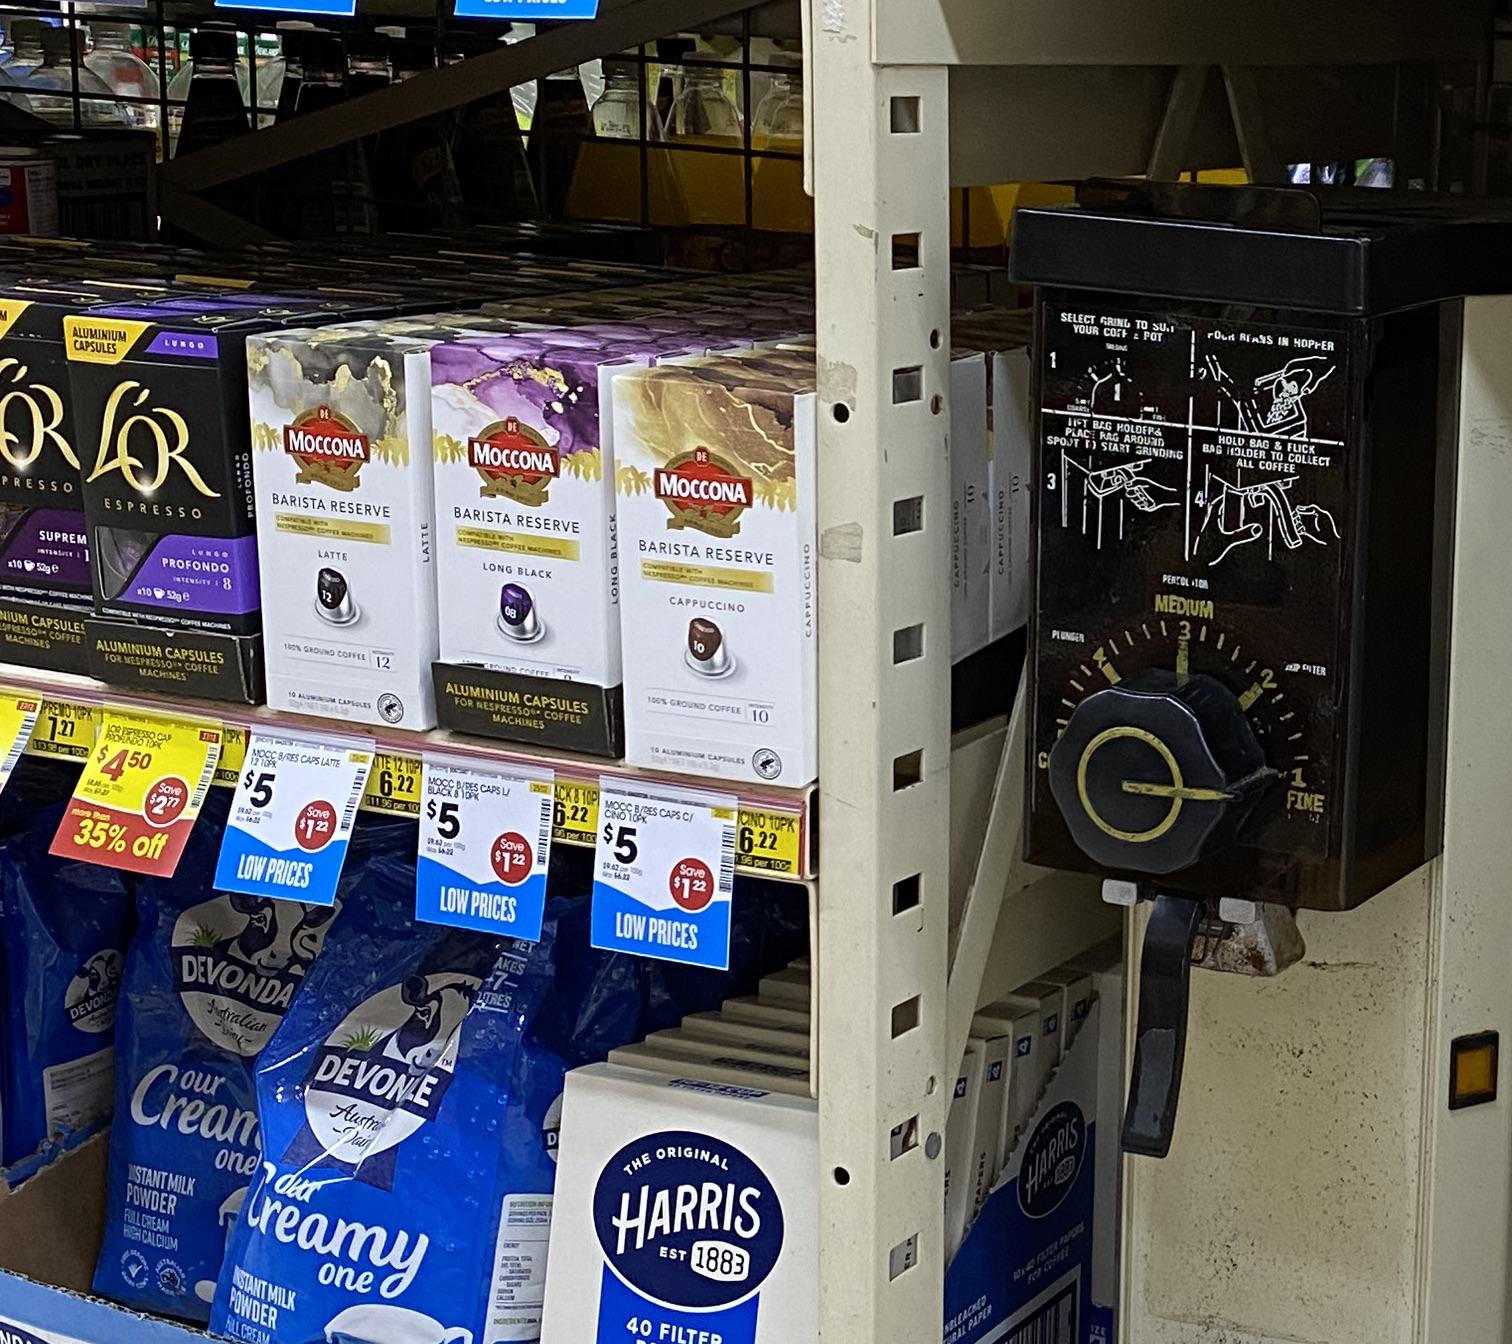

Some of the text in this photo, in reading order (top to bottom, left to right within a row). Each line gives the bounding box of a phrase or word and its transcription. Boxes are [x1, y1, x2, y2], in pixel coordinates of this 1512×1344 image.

[72, 326, 127, 342] ALUMINIUM
[73, 340, 118, 355] CAPSULES
[1218, 436, 1273, 450] HOLD BAG
[659, 471, 747, 503] MOCCONA
[638, 539, 774, 566] BARISTA RESERVE
[162, 557, 229, 573] PROFONDO
[482, 562, 553, 580] LONG BLACK
[669, 596, 746, 613] CAPPUCCINO
[1154, 594, 1214, 619] MEDIUM
[1179, 621, 1191, 639] 3
[1287, 791, 1325, 813] FINE
[73, 819, 170, 860] 35% off
[623, 1146, 729, 1176] THE ORIGINAL
[612, 1182, 761, 1255] HARRIS
[626, 1317, 654, 1336] 40
